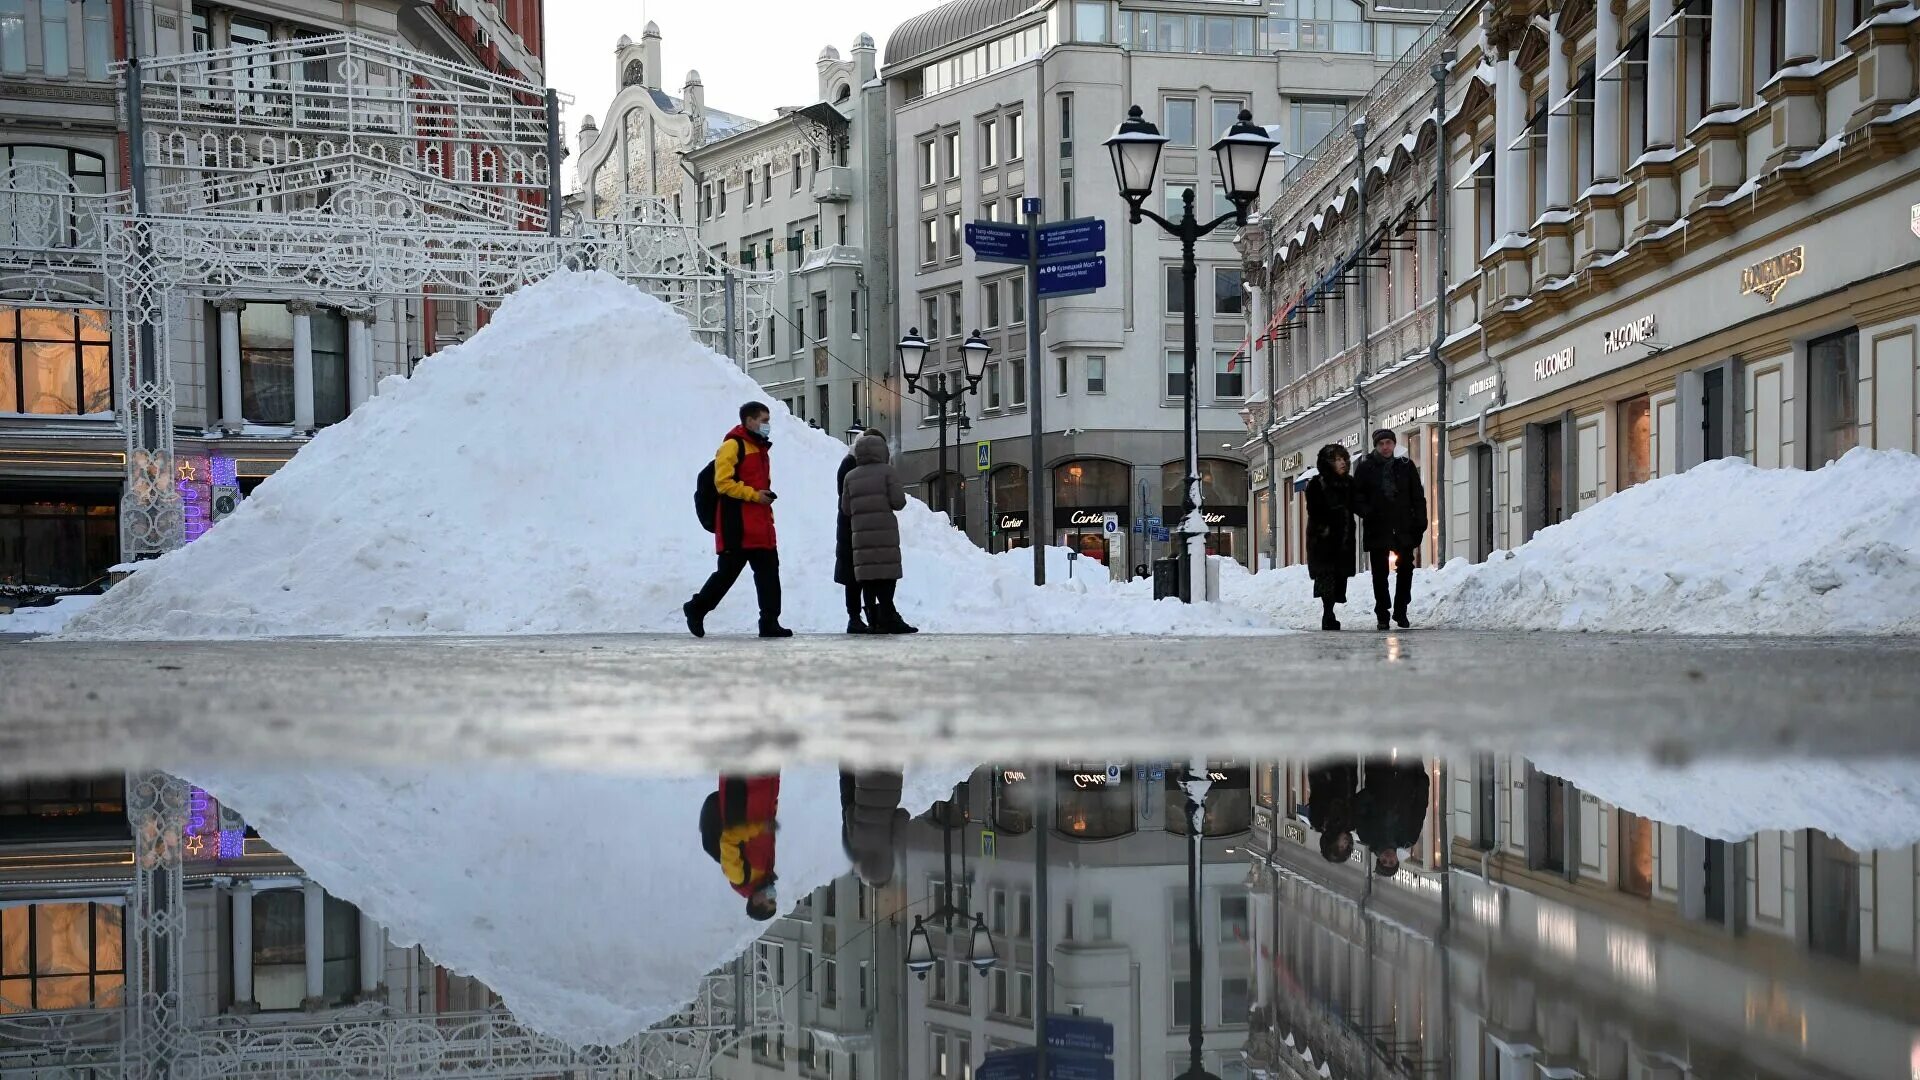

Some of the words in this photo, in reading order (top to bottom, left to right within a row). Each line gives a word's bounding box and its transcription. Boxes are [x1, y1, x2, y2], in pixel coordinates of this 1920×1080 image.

[1740, 246, 1803, 293] LONGINES
[1604, 313, 1655, 355] FALCONERI
[1534, 346, 1575, 382] FALCONERI
[1001, 515, 1023, 528] Cartier
[1071, 510, 1104, 524] Cartie
[1202, 512, 1226, 523] tier
